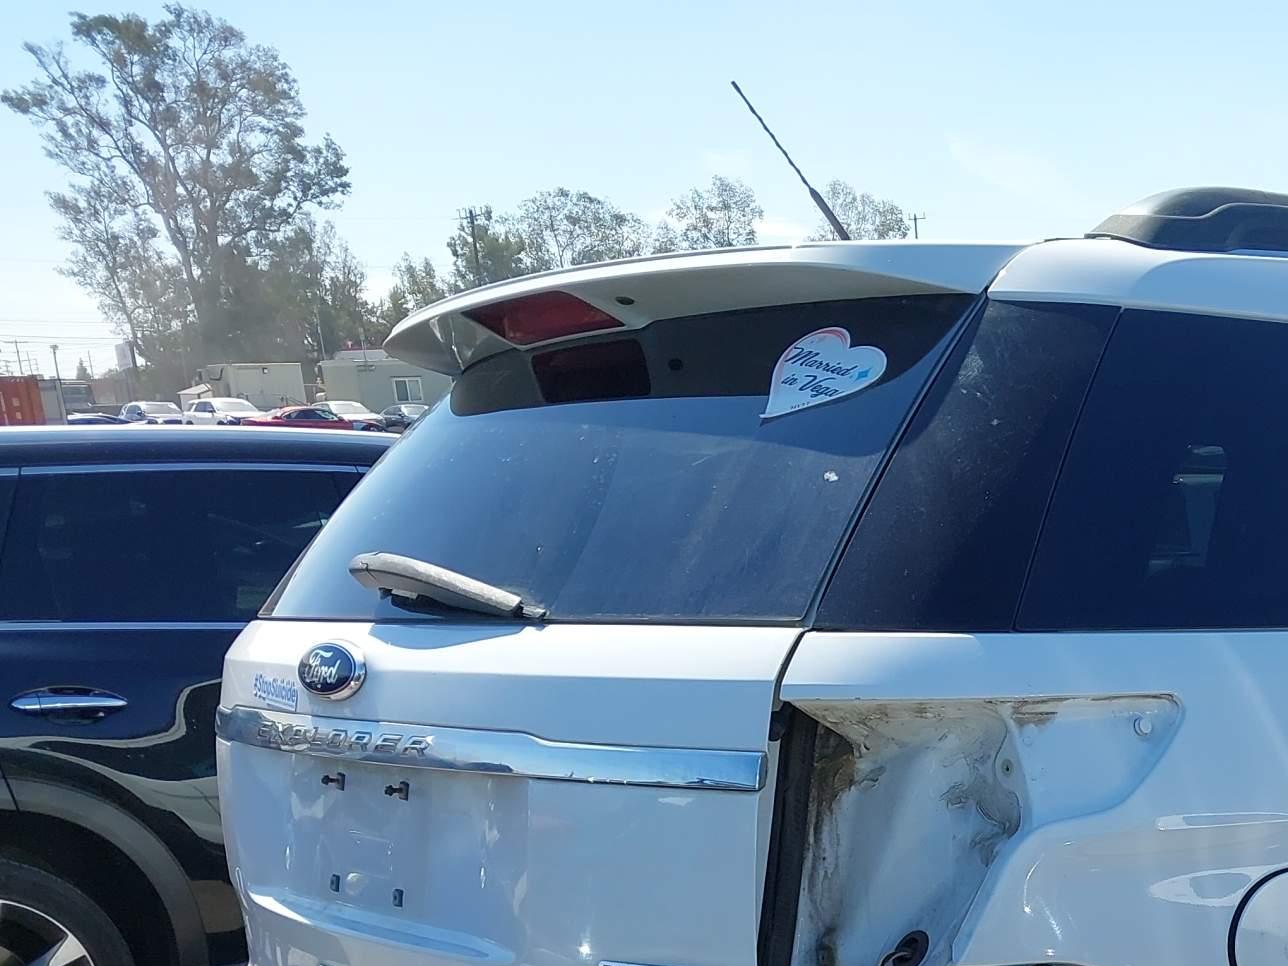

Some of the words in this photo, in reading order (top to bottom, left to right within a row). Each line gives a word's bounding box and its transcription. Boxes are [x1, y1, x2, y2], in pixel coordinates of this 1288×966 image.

[784, 346, 858, 377] Married
[781, 373, 799, 386] in
[305, 650, 341, 684] Ford
[256, 720, 433, 760] EXPLORER
